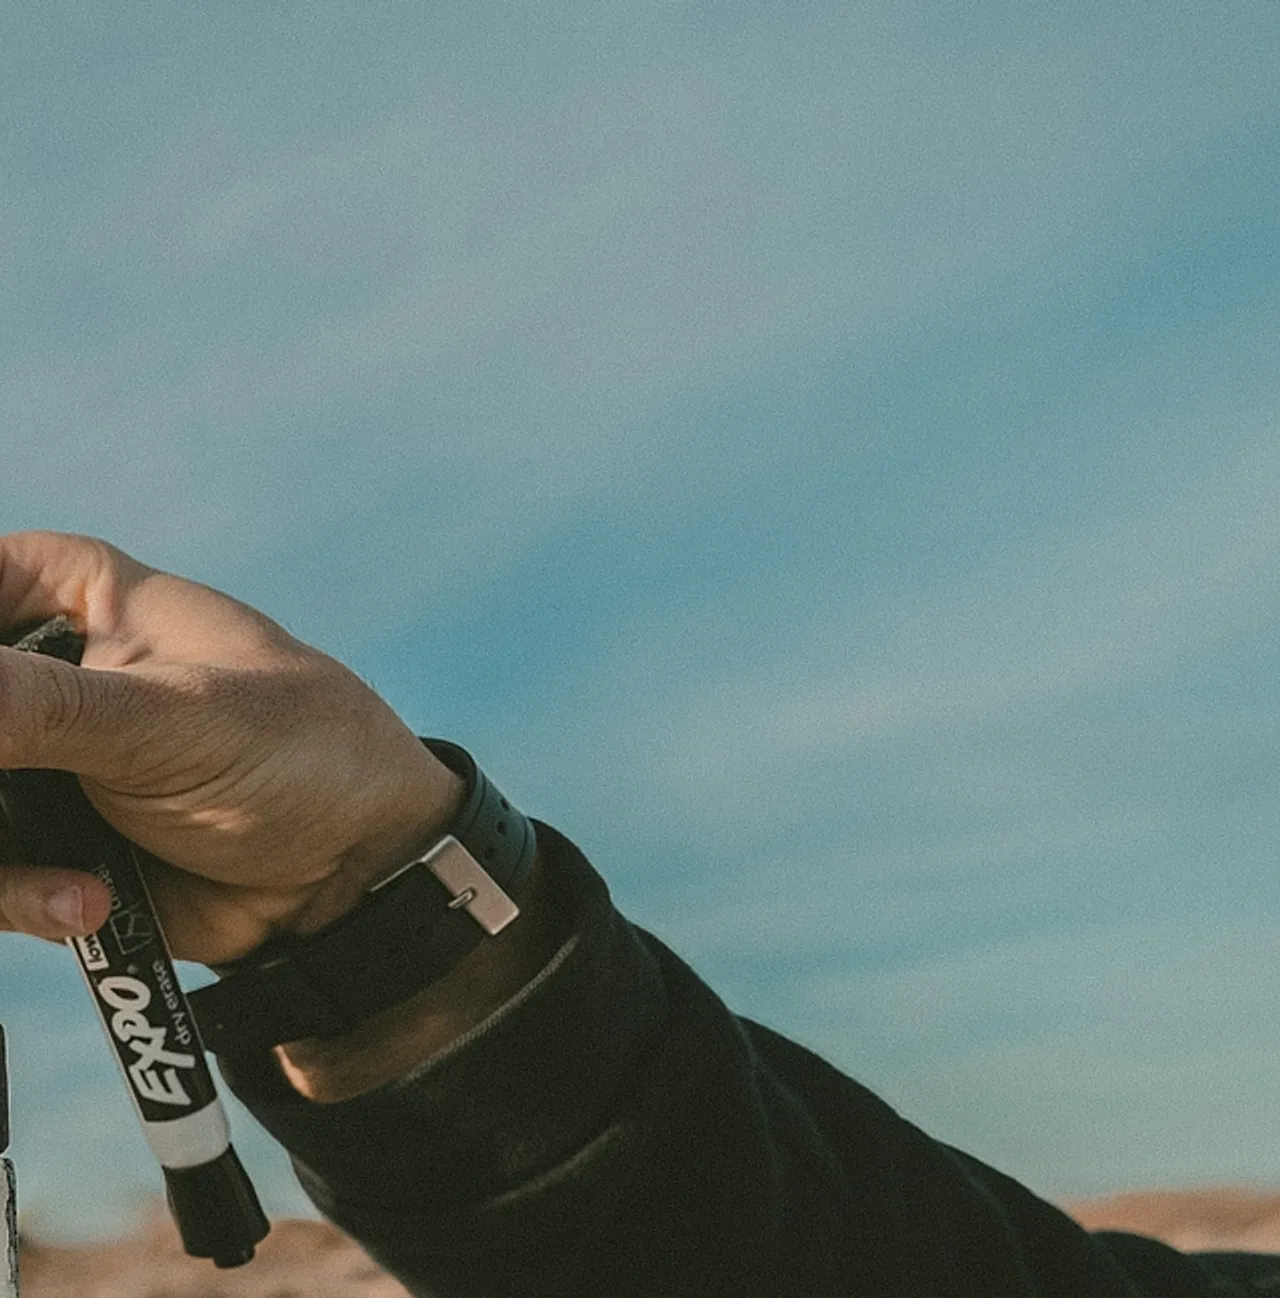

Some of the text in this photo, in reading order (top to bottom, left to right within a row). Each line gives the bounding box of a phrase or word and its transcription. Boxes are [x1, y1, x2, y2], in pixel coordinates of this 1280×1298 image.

[98, 975, 196, 1106] EXPO
[152, 960, 192, 1046] dry erase
